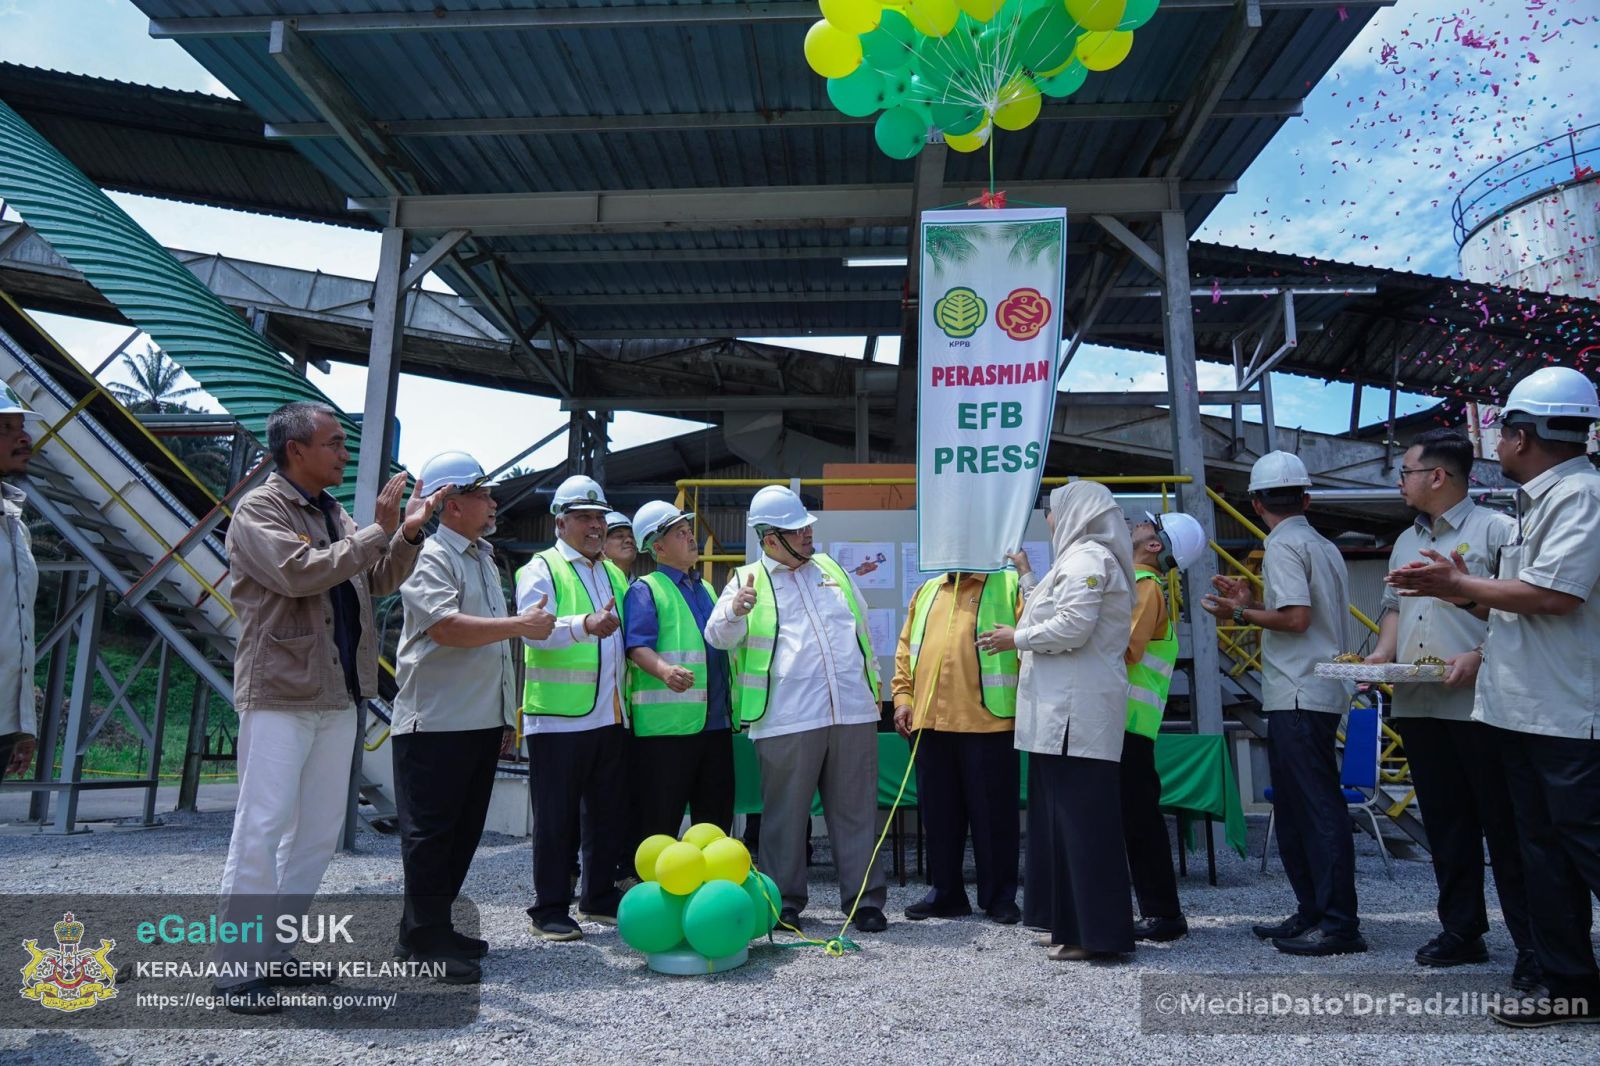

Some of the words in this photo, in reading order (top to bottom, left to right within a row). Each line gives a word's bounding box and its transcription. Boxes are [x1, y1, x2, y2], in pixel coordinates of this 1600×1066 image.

[949, 340, 971, 348] KPPB
[931, 360, 1049, 387] PERASMIAN
[957, 401, 1023, 430] EFB
[934, 441, 1041, 475] PRESS
